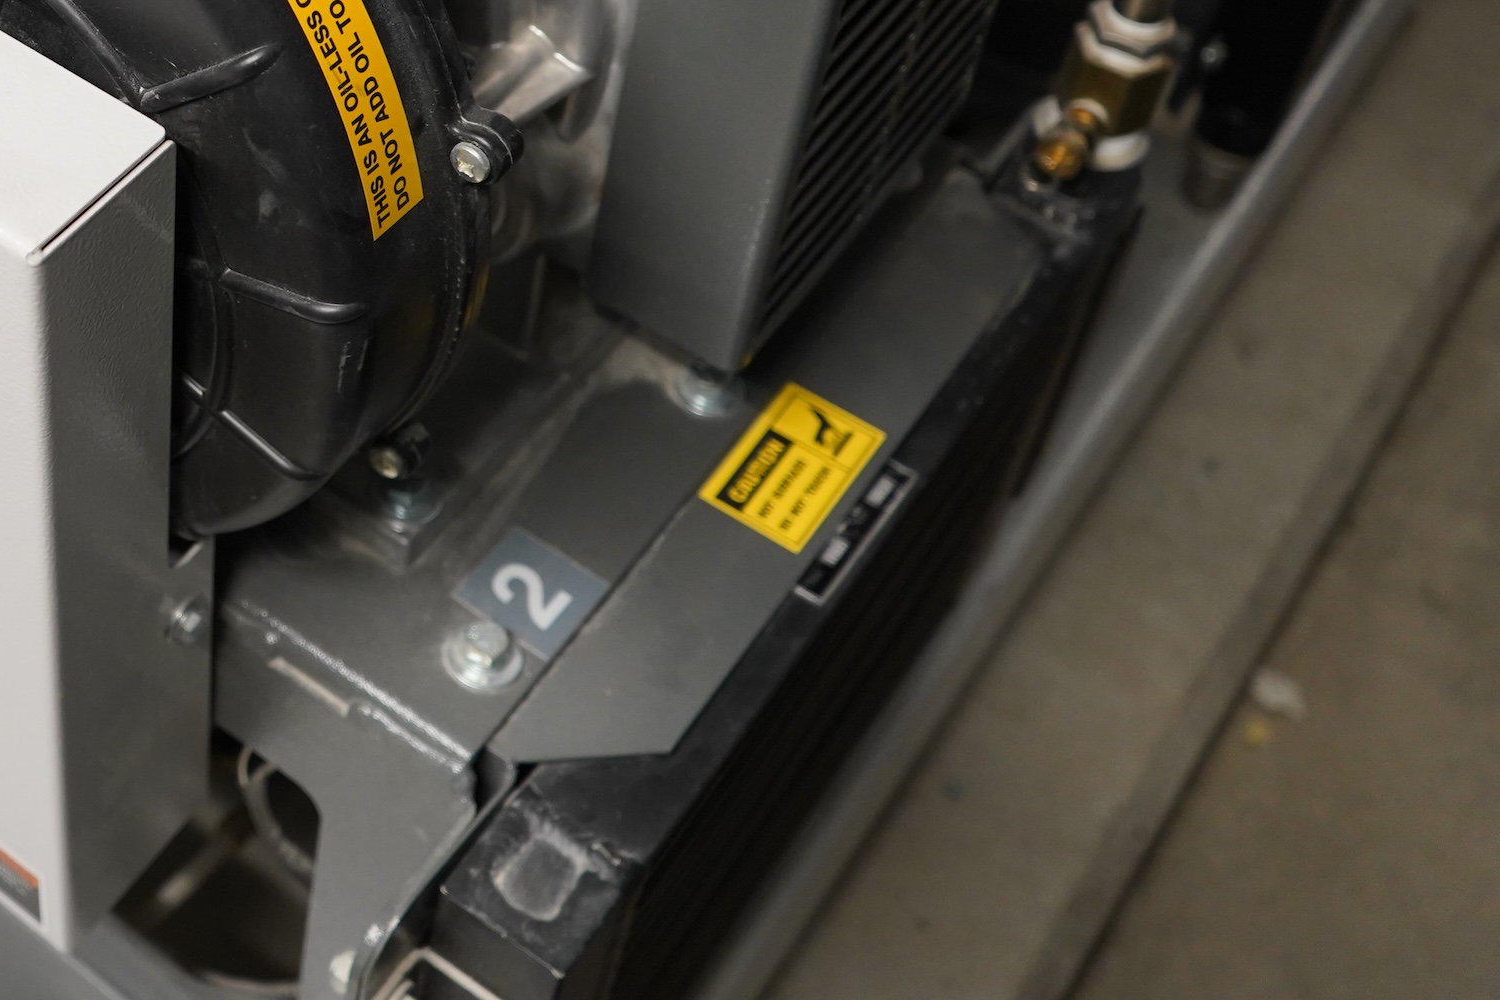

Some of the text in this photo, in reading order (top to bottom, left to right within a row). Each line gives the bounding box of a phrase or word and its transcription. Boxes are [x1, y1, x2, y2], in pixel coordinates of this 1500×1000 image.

[329, 0, 352, 35] TO
[306, 10, 359, 112] OIL-LESS
[347, 31, 370, 74] OIL
[363, 76, 390, 123] ADD
[351, 113, 372, 146] AN
[379, 128, 403, 175] NOT
[363, 149, 380, 175] IS
[370, 175, 391, 228] THIS
[393, 176, 410, 211] DO
[491, 563, 574, 632] 2
